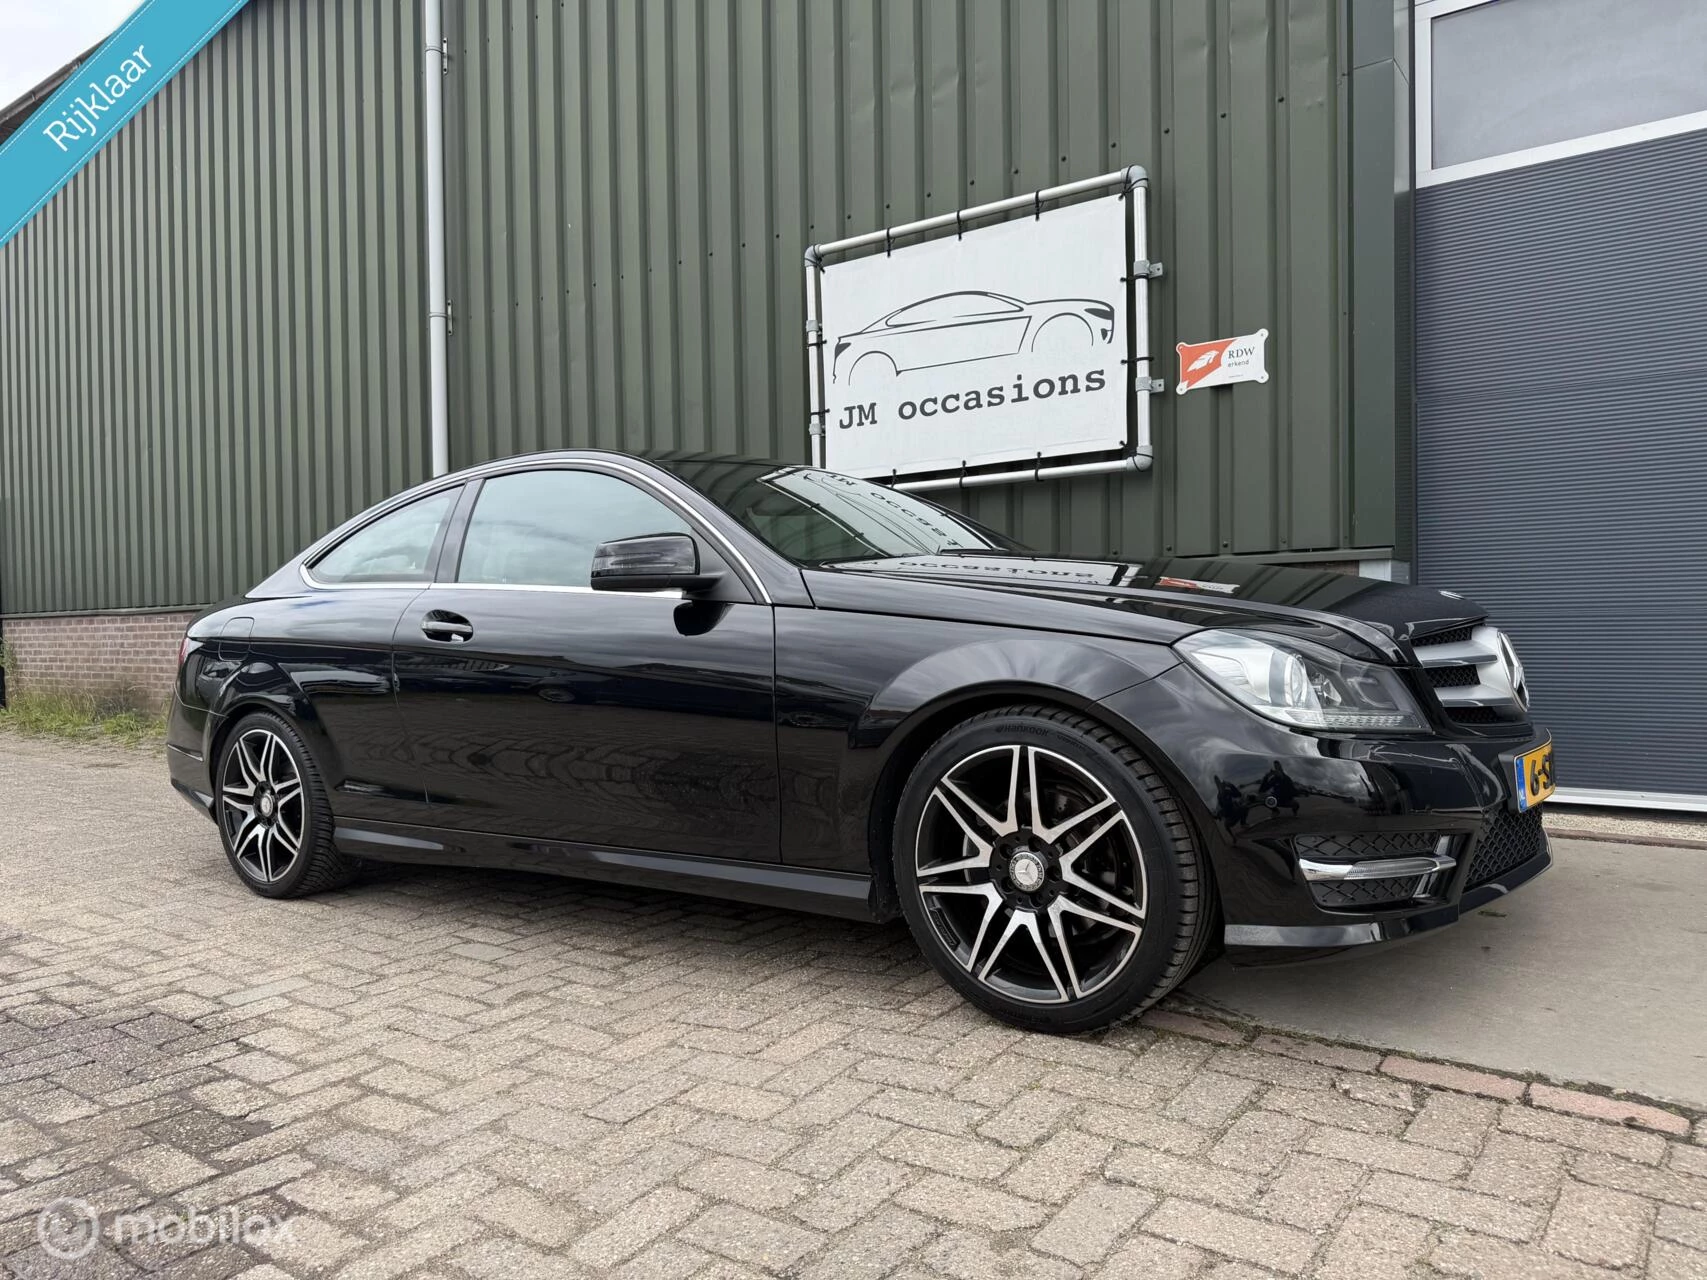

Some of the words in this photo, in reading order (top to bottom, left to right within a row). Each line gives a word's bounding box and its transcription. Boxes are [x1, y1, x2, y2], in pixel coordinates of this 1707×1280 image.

[1228, 347, 1254, 359] RDW
[839, 403, 878, 430] JM
[898, 368, 1107, 421] occasions
